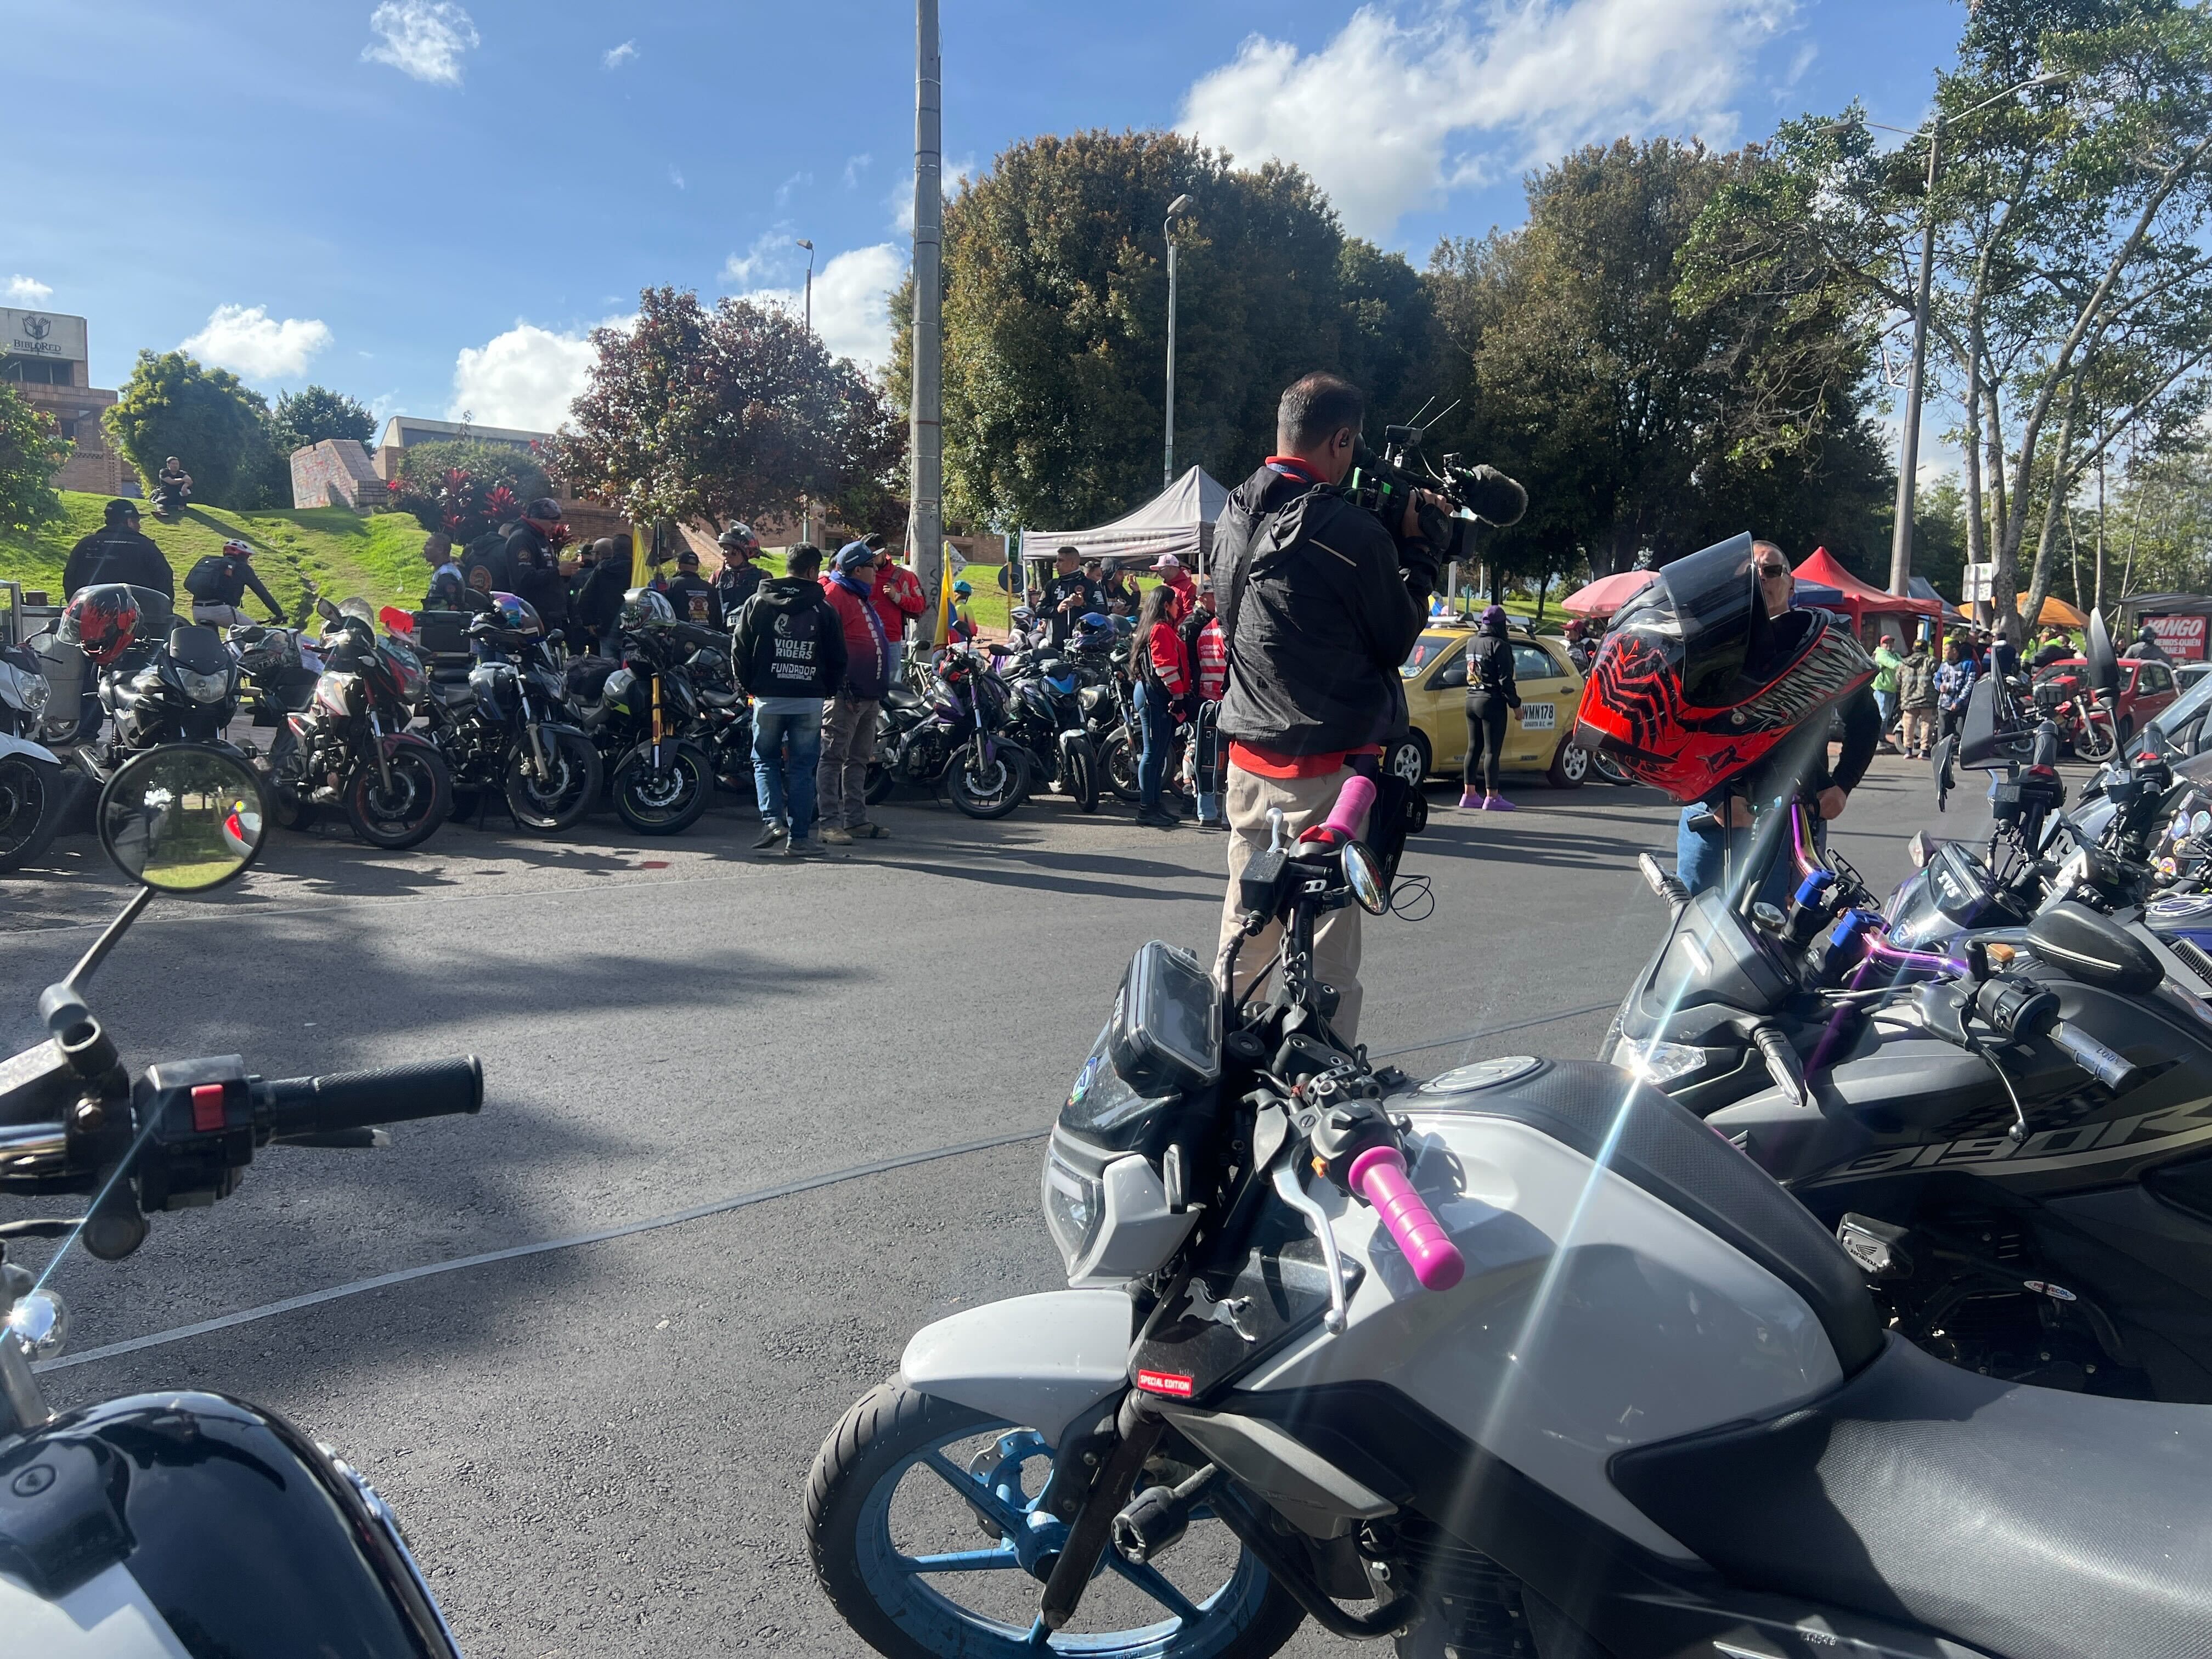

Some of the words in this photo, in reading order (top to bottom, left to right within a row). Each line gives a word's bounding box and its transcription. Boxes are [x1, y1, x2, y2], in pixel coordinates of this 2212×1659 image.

[2148, 619, 2203, 636] YANGO
[775, 638, 815, 651] VIOLET
[2179, 637, 2201, 646] QUIÉN
[776, 647, 812, 659] RIDERS
[1522, 704, 1554, 720] WMN178
[1937, 870, 1961, 898] TVS
[2033, 1282, 2070, 1297] PRVECOL
[1140, 1374, 1164, 1387] SPECIAL
[1164, 1379, 1190, 1391] EDITION
